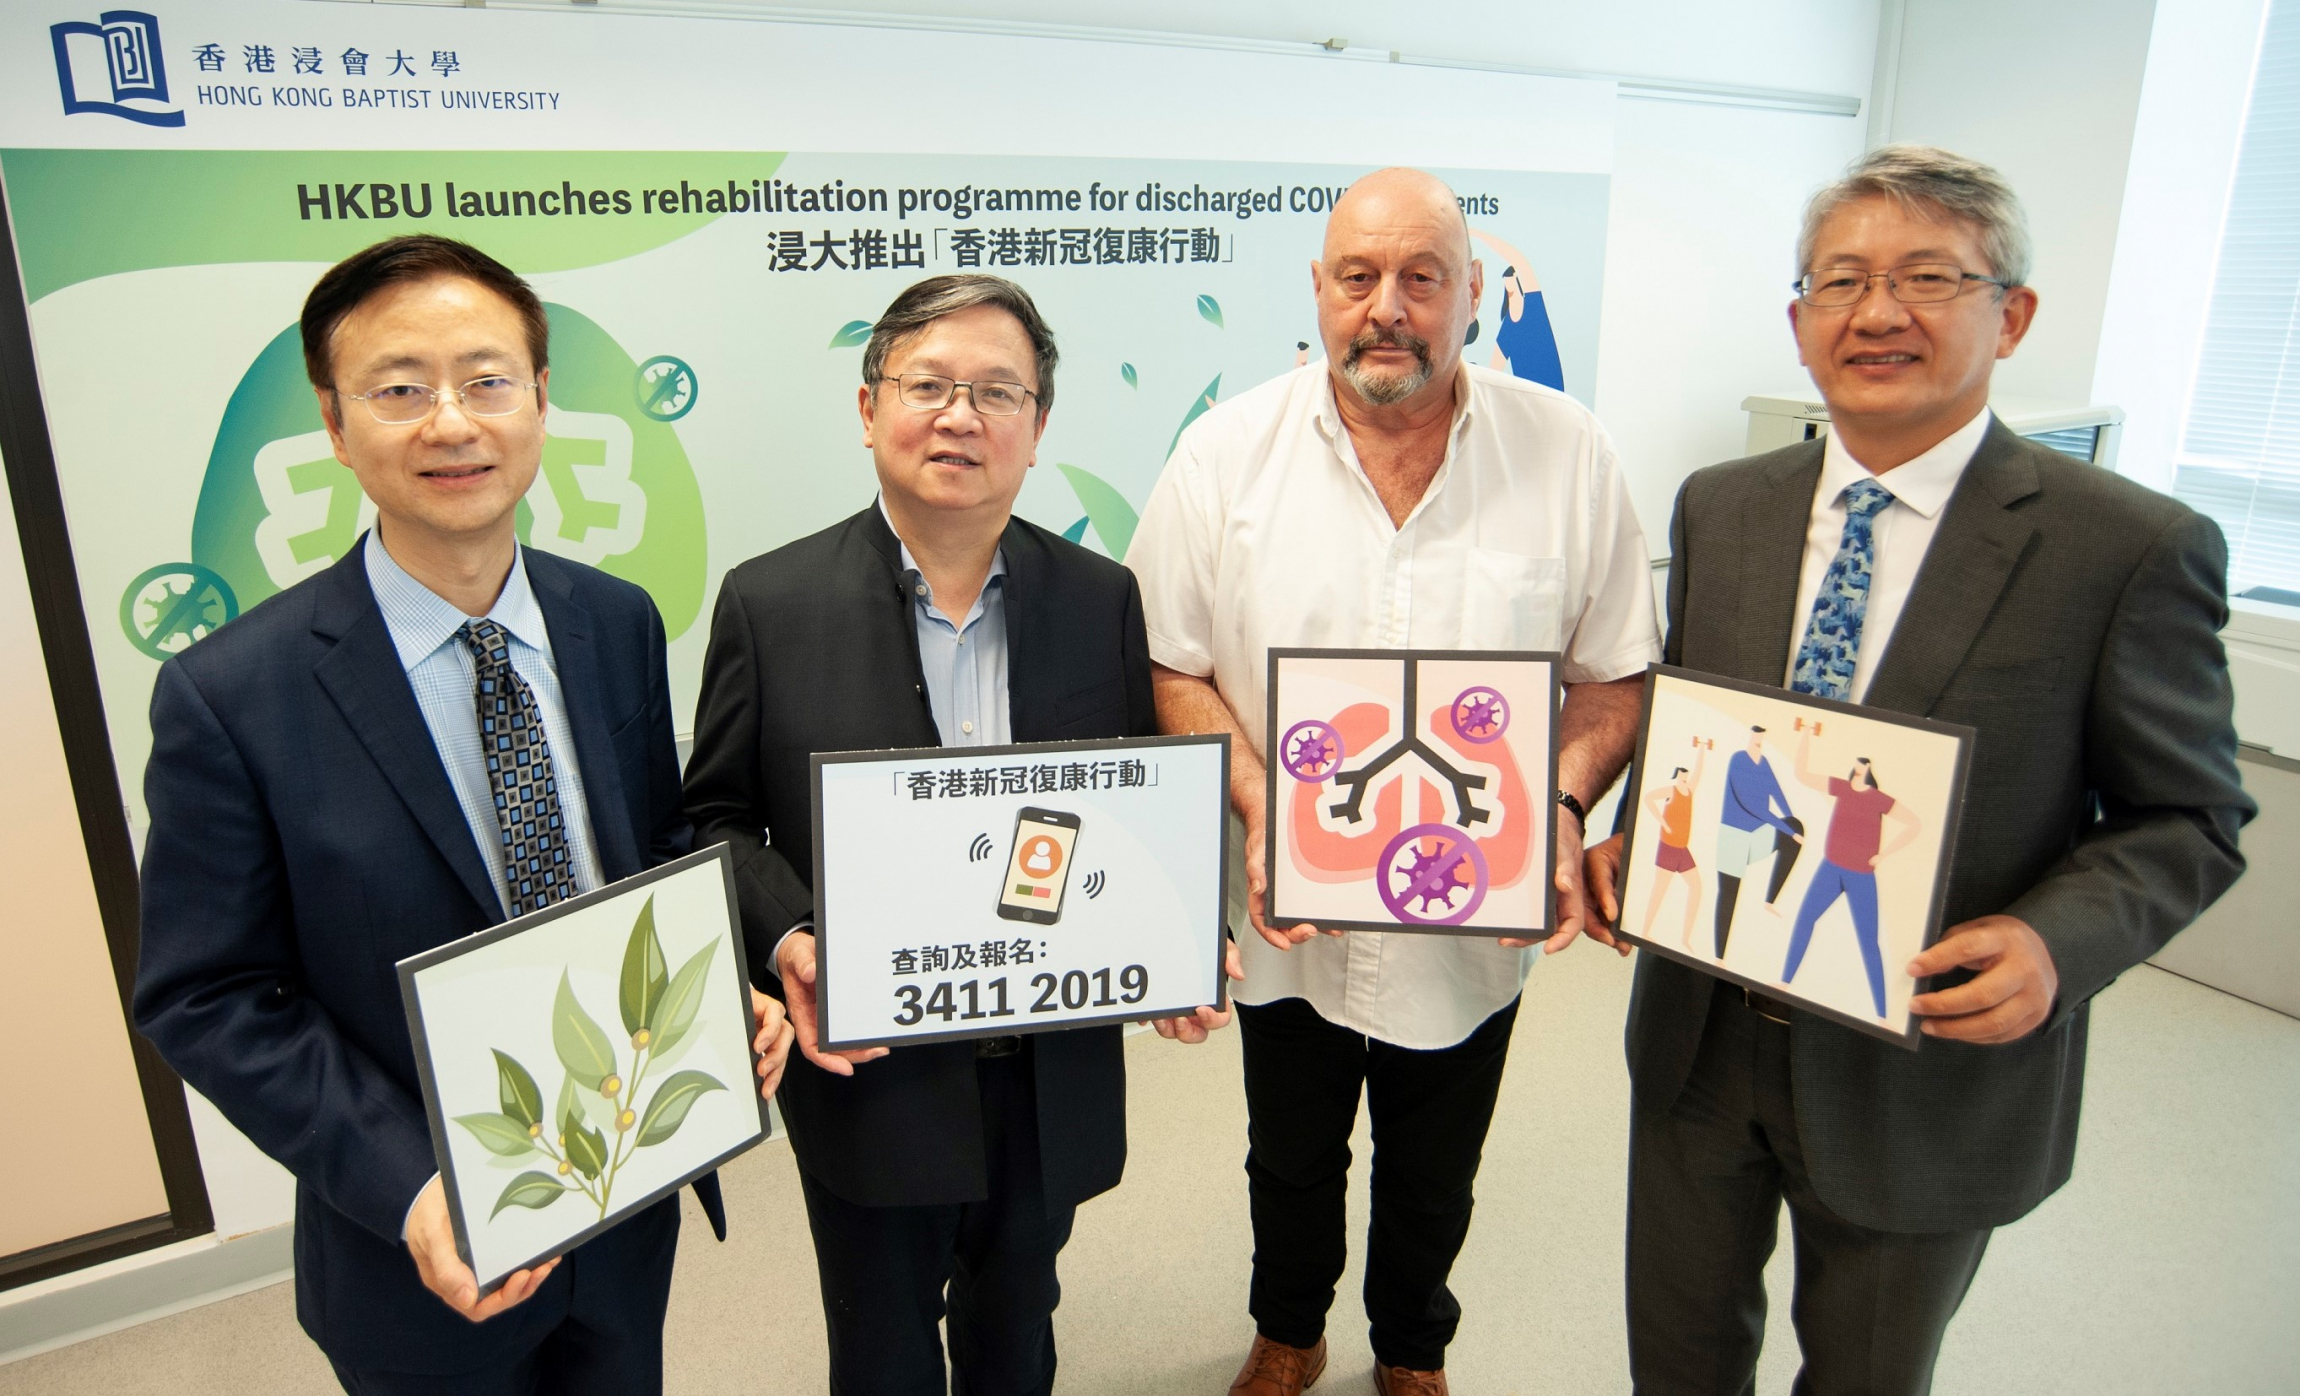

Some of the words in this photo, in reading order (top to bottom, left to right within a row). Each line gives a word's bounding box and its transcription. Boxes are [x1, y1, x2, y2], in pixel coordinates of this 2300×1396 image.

[192, 43, 461, 78] 香港浸會大學
[197, 85, 262, 106] HONG
[272, 87, 332, 107] KONG
[343, 89, 431, 108] BAPTIST
[441, 91, 560, 110] UNIVERSITY
[297, 183, 433, 220] HKBU
[445, 181, 632, 217] launches
[643, 179, 888, 214] rehabilitation
[899, 185, 1081, 220] programme
[1089, 182, 1129, 211] for
[1136, 183, 1282, 219] discharged
[1290, 186, 1348, 213] COV
[1457, 193, 1499, 215] ents
[892, 759, 1160, 801] 「香港新冠復康行動」
[892, 976, 1015, 1027] 3411
[1030, 964, 1149, 1013] 2019
